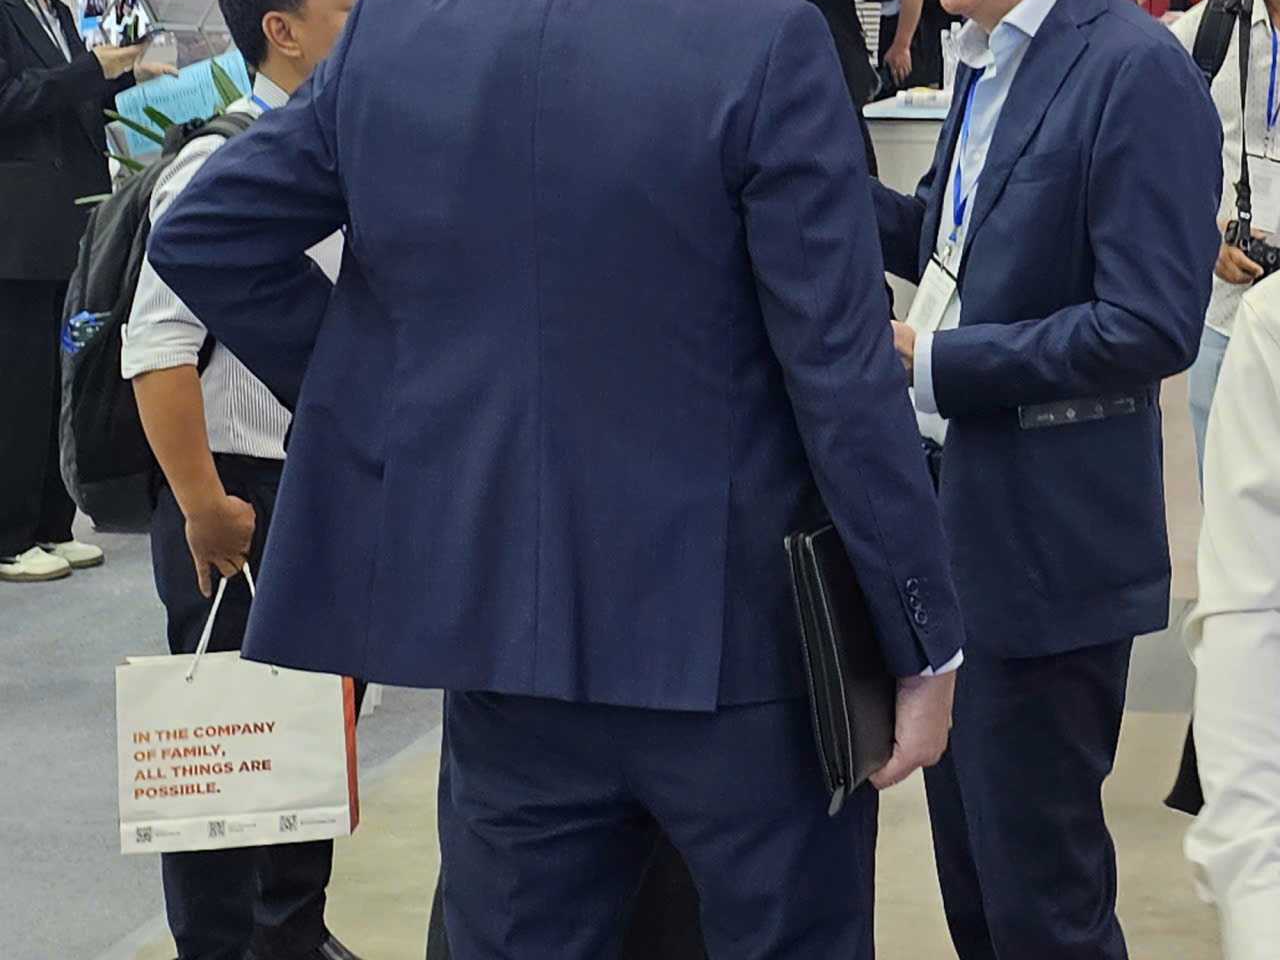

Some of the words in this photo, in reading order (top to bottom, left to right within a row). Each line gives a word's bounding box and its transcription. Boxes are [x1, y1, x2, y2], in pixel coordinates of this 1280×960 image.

[133, 731, 151, 744] IN
[156, 728, 189, 742] THE
[193, 721, 276, 739] COMPANY
[134, 749, 156, 763] OF
[161, 743, 227, 760] FAMILY,
[134, 767, 167, 782] ALL
[171, 760, 234, 778] THINGS
[238, 759, 273, 773] ARE
[134, 782, 222, 800] POSSIBLE.
